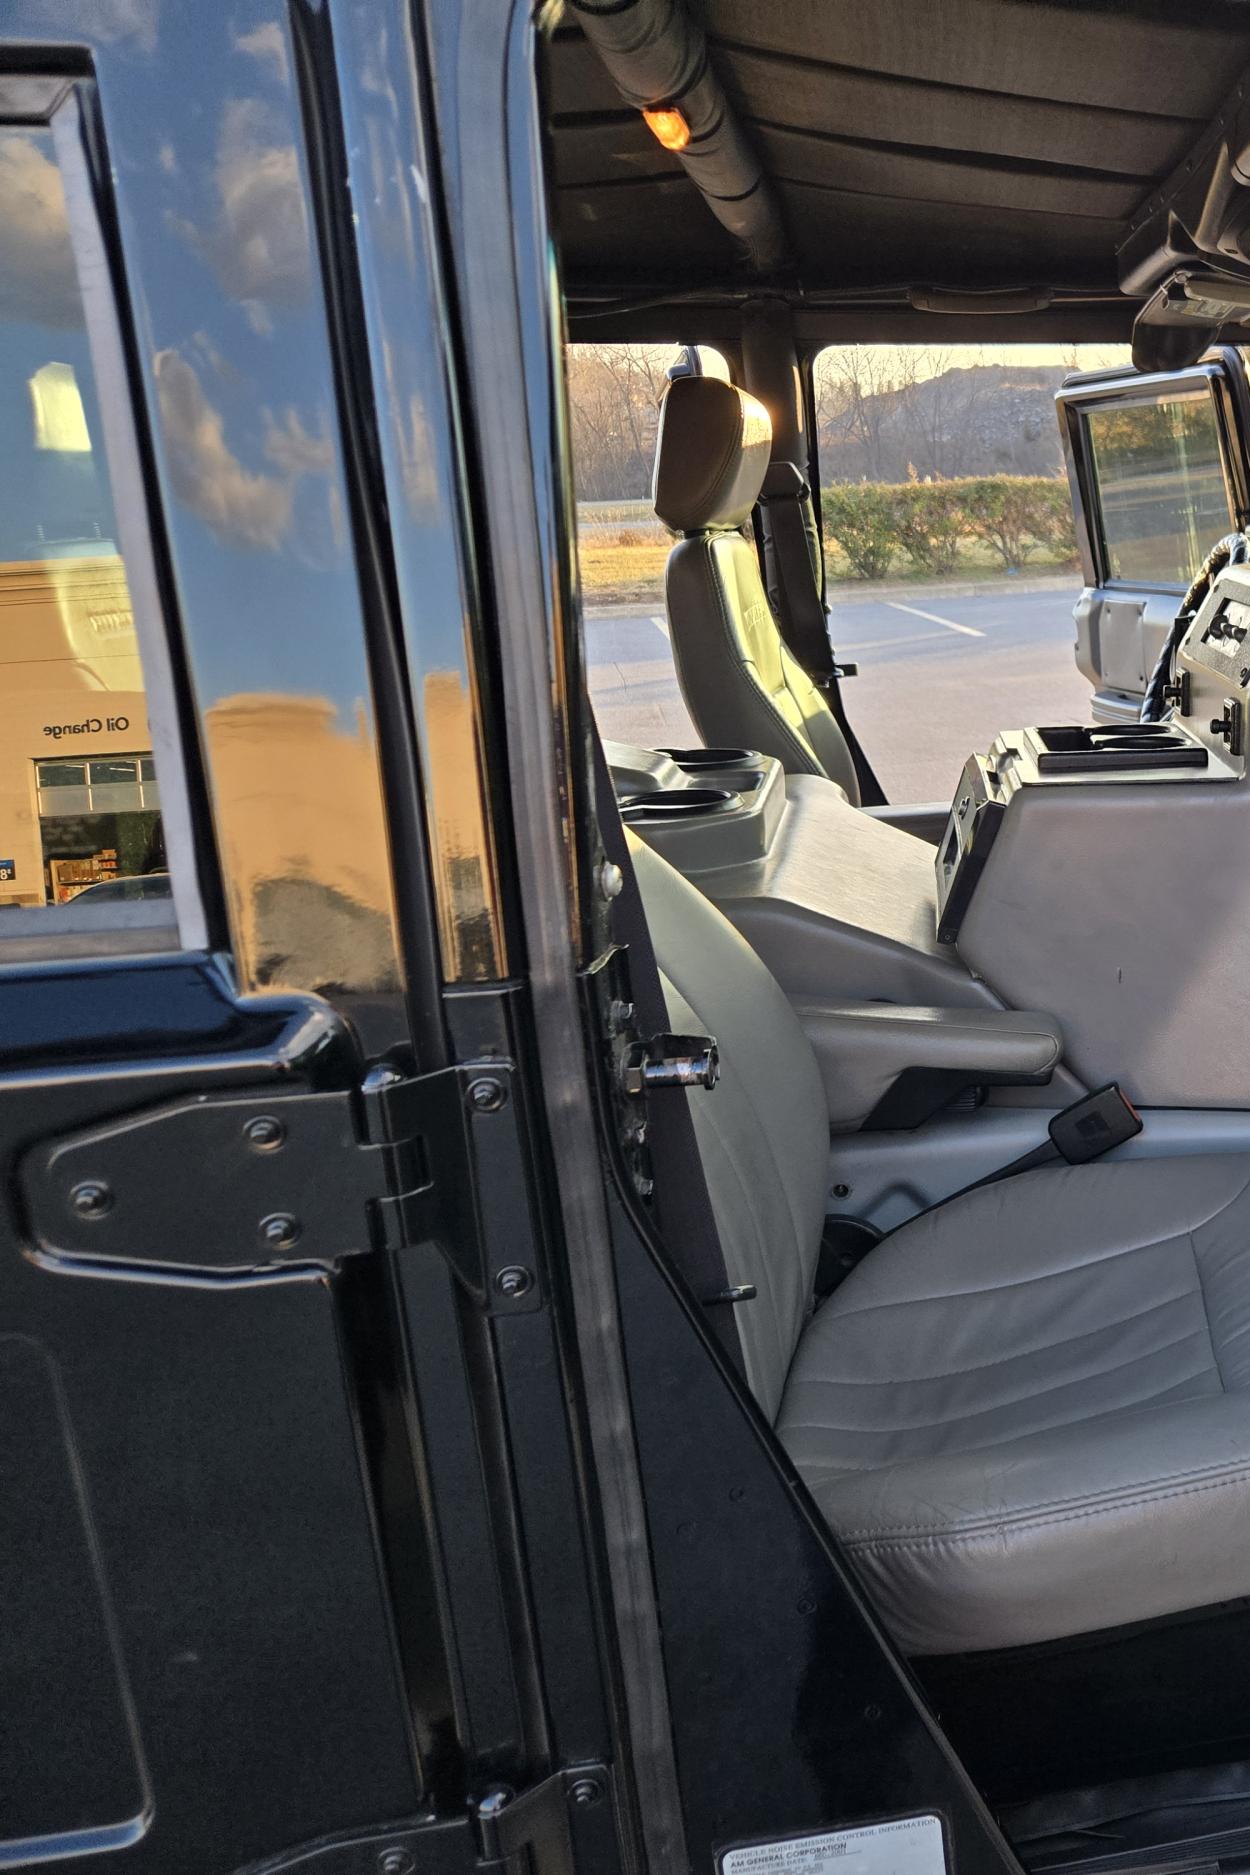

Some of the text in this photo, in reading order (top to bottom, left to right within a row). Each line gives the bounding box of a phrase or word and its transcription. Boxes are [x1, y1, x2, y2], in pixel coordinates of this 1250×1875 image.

[729, 1849, 766, 1860] VEHICLE
[795, 1836, 835, 1849] EMISSION
[836, 1829, 876, 1842] CONTROL
[878, 1818, 937, 1835] INFORMATION
[730, 1861, 746, 1869] AM
[746, 1855, 783, 1866] GENERAL
[786, 1842, 847, 1858] CORPORATION
